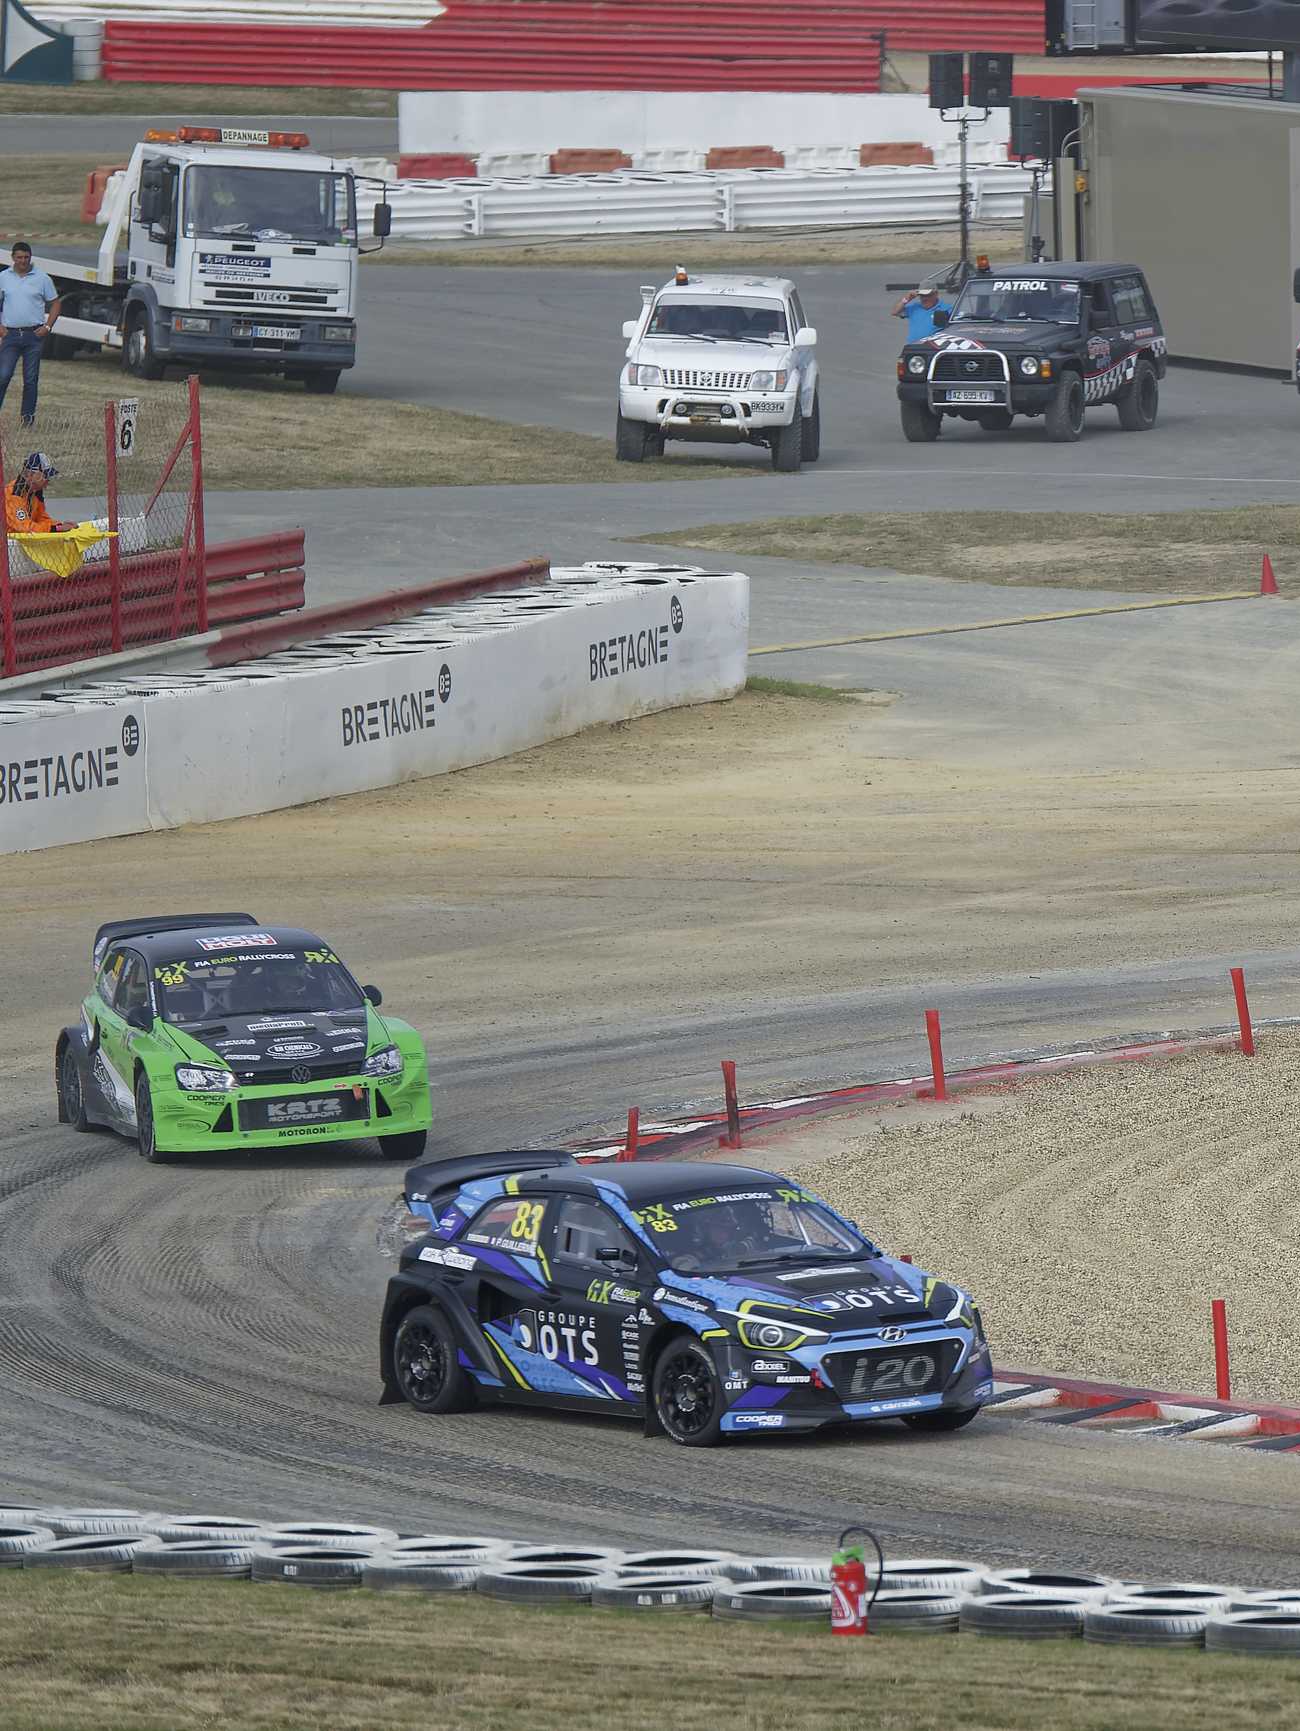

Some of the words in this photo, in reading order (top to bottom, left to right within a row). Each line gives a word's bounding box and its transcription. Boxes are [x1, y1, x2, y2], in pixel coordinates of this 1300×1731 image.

[214, 256, 265, 267] PEUGEOT
[992, 280, 1049, 292] PATROL
[253, 292, 290, 302] IVECO
[120, 403, 137, 416] POSTE
[120, 420, 133, 449] 6
[589, 625, 669, 681] BRETAGNE
[342, 689, 435, 747] BRETAGNE
[194, 960, 211, 968] FIA
[211, 956, 237, 965] EURO
[239, 953, 296, 961] RALLYCROSS
[268, 1110, 343, 1122] MOTORSPORT
[278, 1127, 326, 1137] MOTORON
[672, 1202, 690, 1211] FIA
[689, 1197, 716, 1207] EURO
[715, 1192, 773, 1203] RALLYCROSS
[511, 1202, 544, 1240] 83
[651, 1219, 678, 1232] 83
[845, 1289, 921, 1308] OTS
[538, 1310, 596, 1329] GROUPE
[540, 1325, 599, 1366] OTS
[850, 1356, 935, 1394] i20
[724, 1380, 748, 1390] OMT
[736, 1415, 783, 1423] COOPER
